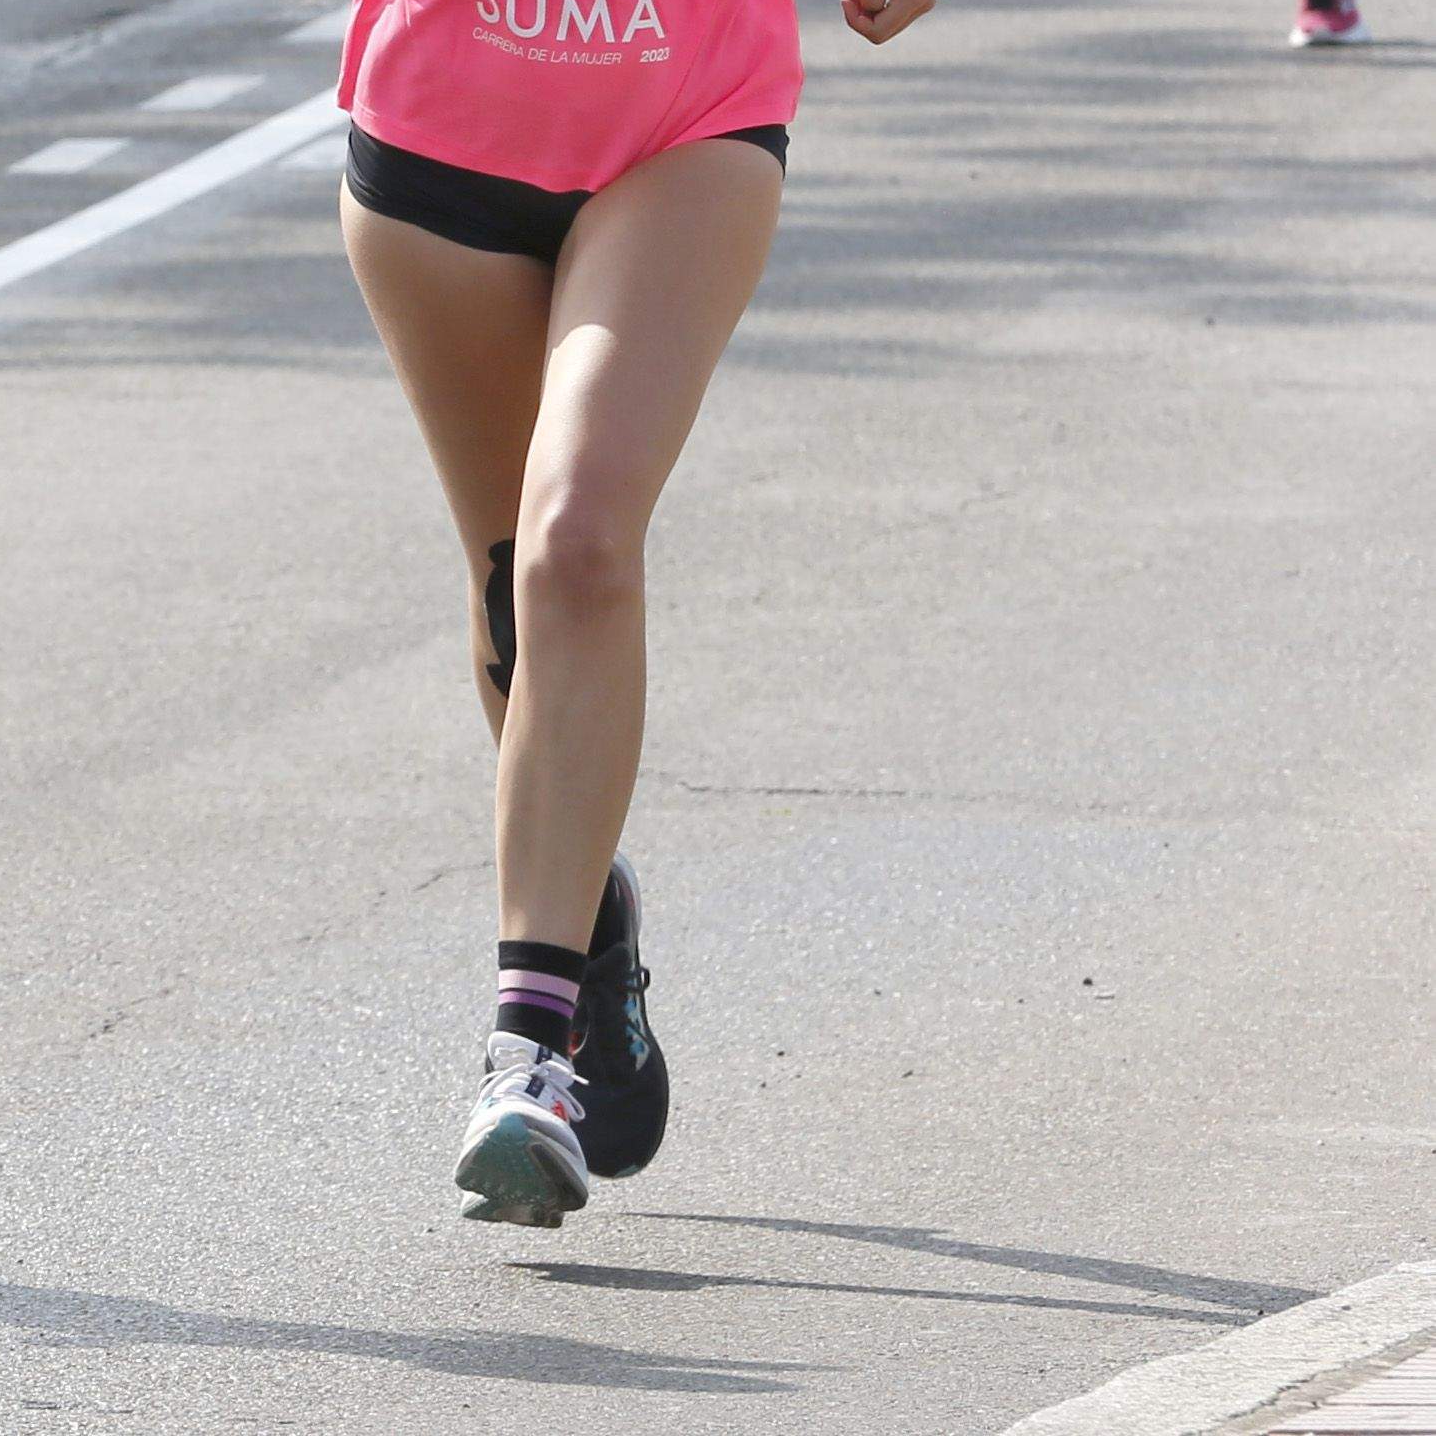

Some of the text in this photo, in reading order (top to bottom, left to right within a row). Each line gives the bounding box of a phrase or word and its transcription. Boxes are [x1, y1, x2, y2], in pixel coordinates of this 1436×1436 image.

[472, 27, 670, 65] CARRERA DE LA MUJER 2023
